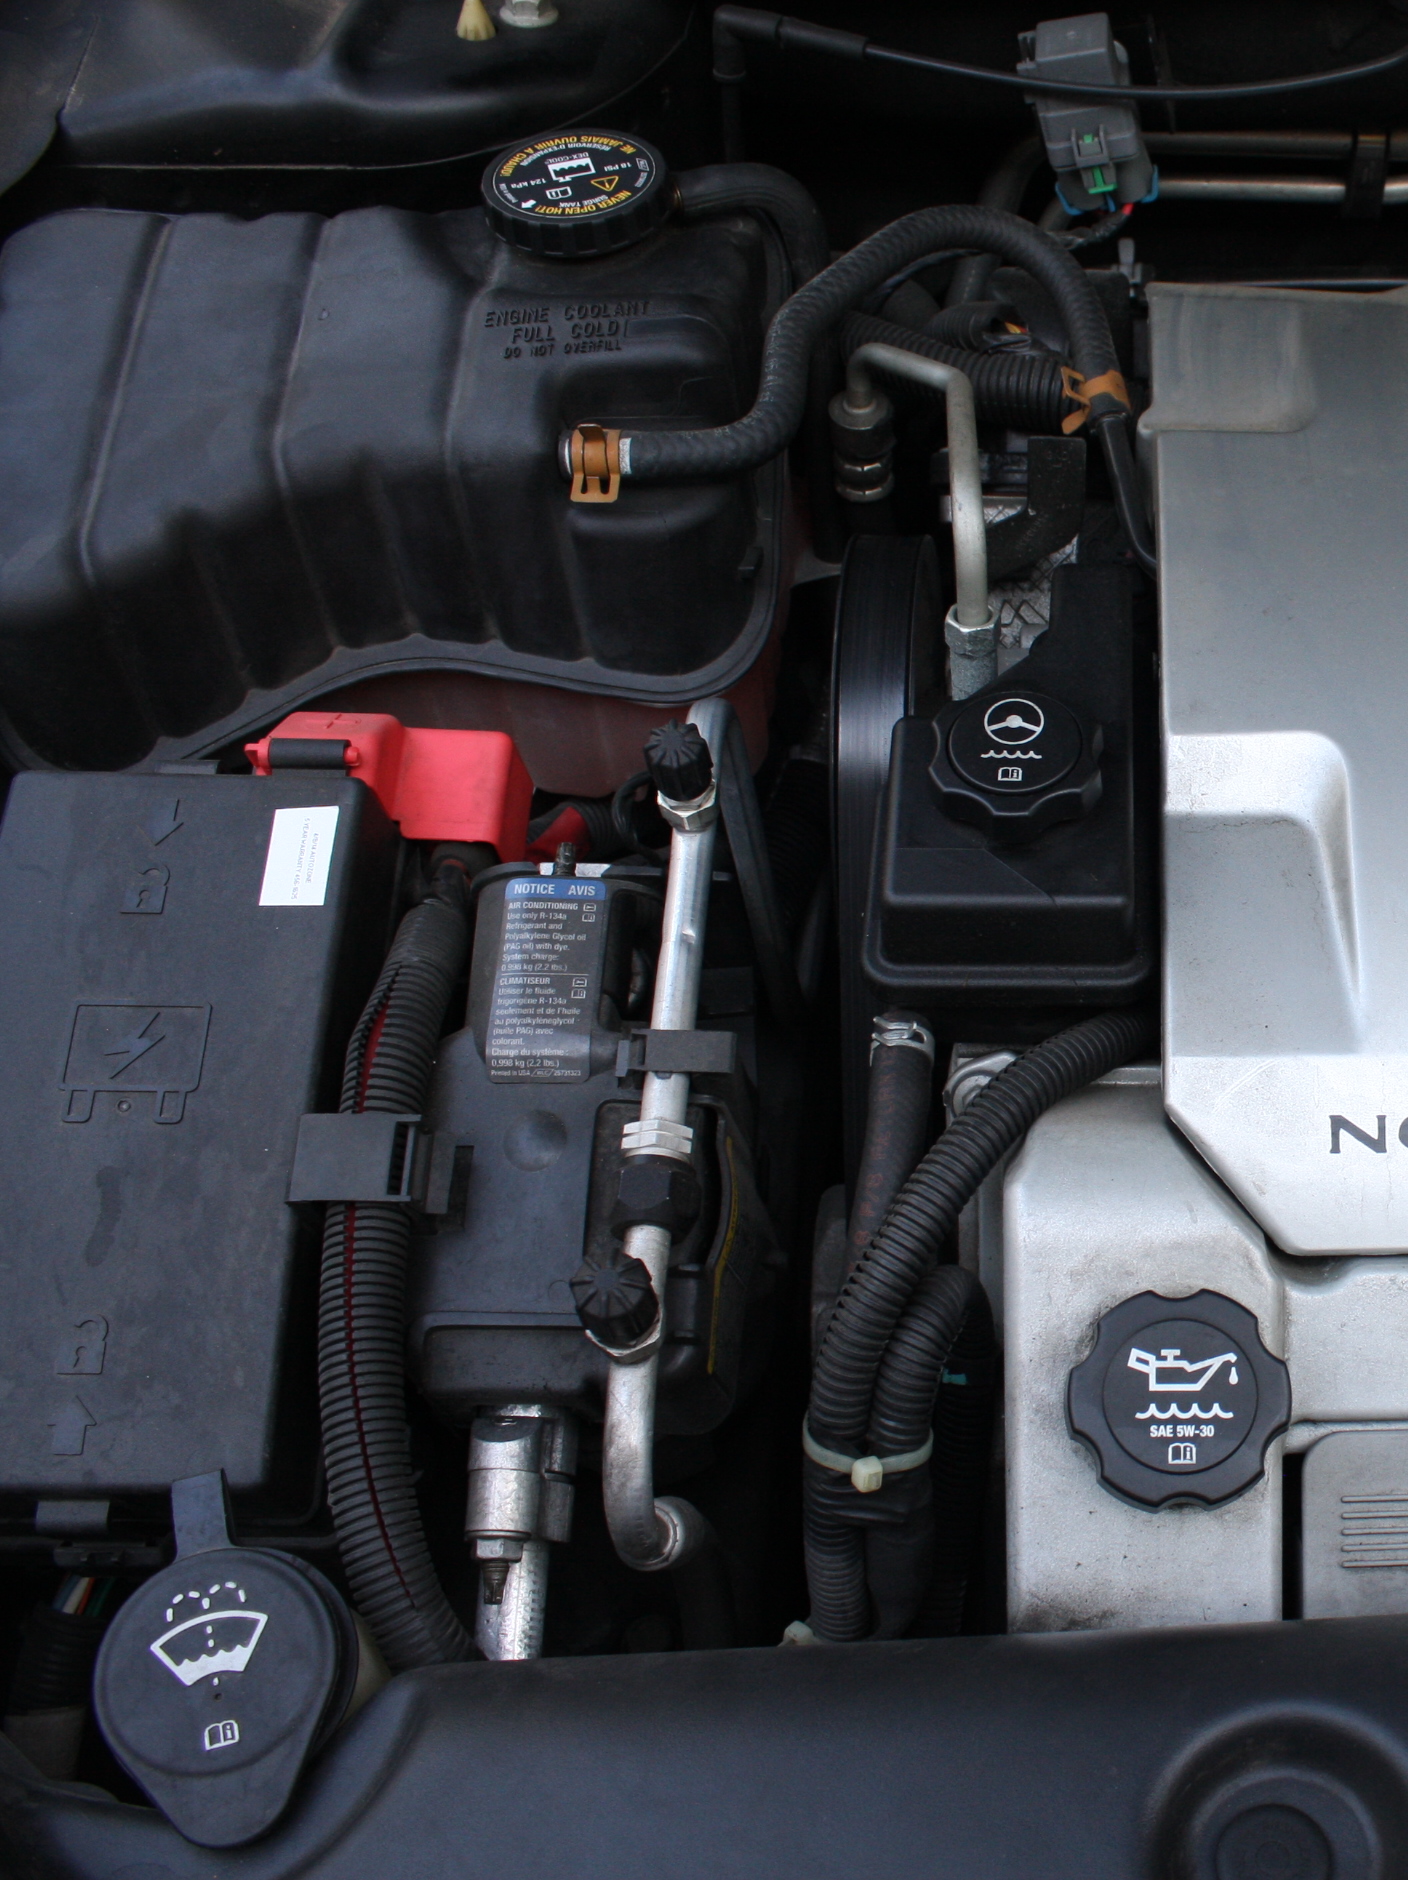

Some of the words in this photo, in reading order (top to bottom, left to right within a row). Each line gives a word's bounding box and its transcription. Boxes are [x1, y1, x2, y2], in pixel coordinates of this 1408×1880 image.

[534, 136, 577, 150] OUVRIR
[581, 136, 623, 147] JAMAIS
[620, 144, 636, 154] NE
[530, 178, 546, 186] 124
[598, 190, 632, 208] NEVER
[535, 205, 562, 215] HOT!
[565, 204, 596, 214] OPEN
[485, 307, 550, 327] ENGINE
[564, 301, 650, 321] COOLANT
[512, 325, 555, 344] FULL
[571, 319, 620, 339] COLD
[504, 346, 522, 359] DO
[530, 344, 555, 357] NOT
[564, 340, 622, 354] OVERFILL
[514, 884, 555, 895] NOTICE
[568, 885, 596, 896] AVIS
[508, 902, 521, 910] AIR
[523, 901, 578, 910] CONDITIONING
[507, 912, 520, 920] Use
[522, 912, 538, 920] only
[540, 912, 567, 920] R-134a
[506, 922, 547, 930] Refrigerant
[548, 922, 563, 930] and
[552, 933, 575, 941] Glycol
[554, 944, 570, 952] dye.
[503, 953, 529, 962] System
[523, 963, 533, 971] kg
[500, 977, 550, 985] CLIMATISEUR
[491, 1048, 519, 1057] Charge
[514, 1059, 525, 1067] kg
[1149, 1424, 1174, 1438] SAE
[1176, 1424, 1215, 1438] 5W-30
